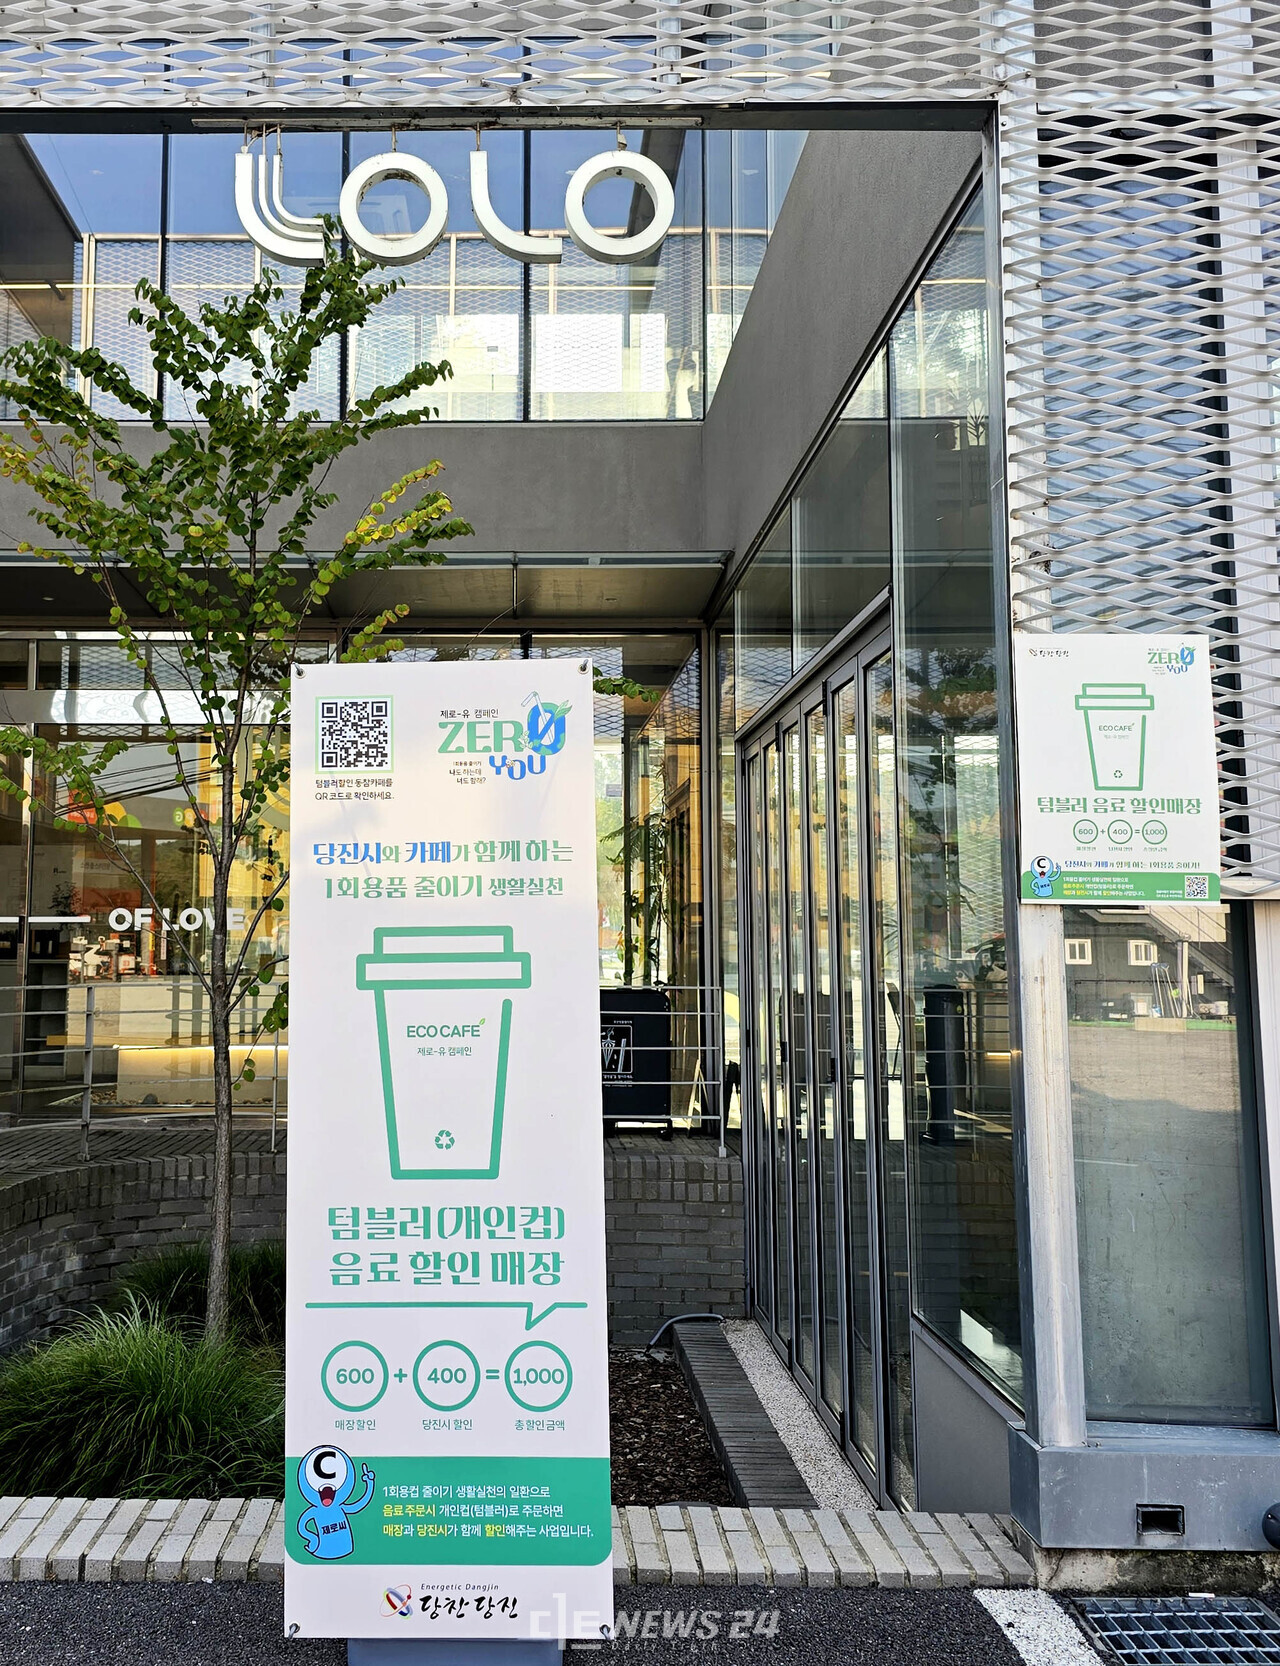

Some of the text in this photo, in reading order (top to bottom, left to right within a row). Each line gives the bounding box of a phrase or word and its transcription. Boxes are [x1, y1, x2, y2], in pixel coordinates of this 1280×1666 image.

[488, 755, 546, 780] YOU
[1038, 796, 1088, 814] 텀블러
[1092, 798, 1126, 814] 음료
[1144, 828, 1164, 838] 1,000
[314, 842, 400, 866] 당진시와
[404, 842, 468, 864] 카페가
[324, 874, 562, 898] 1회용품 줄이기 생활실천
[108, 908, 154, 931] OF
[406, 1024, 480, 1038] ECO CAFE
[328, 1206, 564, 1240] 텀블러(개인컵)
[330, 1252, 564, 1286] 음료 할인 매장
[336, 1368, 374, 1384] 600
[426, 1368, 466, 1384] 400
[510, 1368, 564, 1388] 1,000
[422, 1418, 472, 1430] 당진시 할인
[312, 1451, 336, 1480] C
[382, 1484, 550, 1498] 1회용컵 줄이기 생활실천의 일환으로
[440, 1504, 520, 1518] 개인컵(텀블러)로
[522, 1504, 564, 1518] 주문하면
[322, 1520, 347, 1535] 제로씨
[382, 1524, 594, 1538] 매장과 당진시가 함께 할인해주는 사업입니다.
[420, 1584, 498, 1592] Energetic Dangjin
